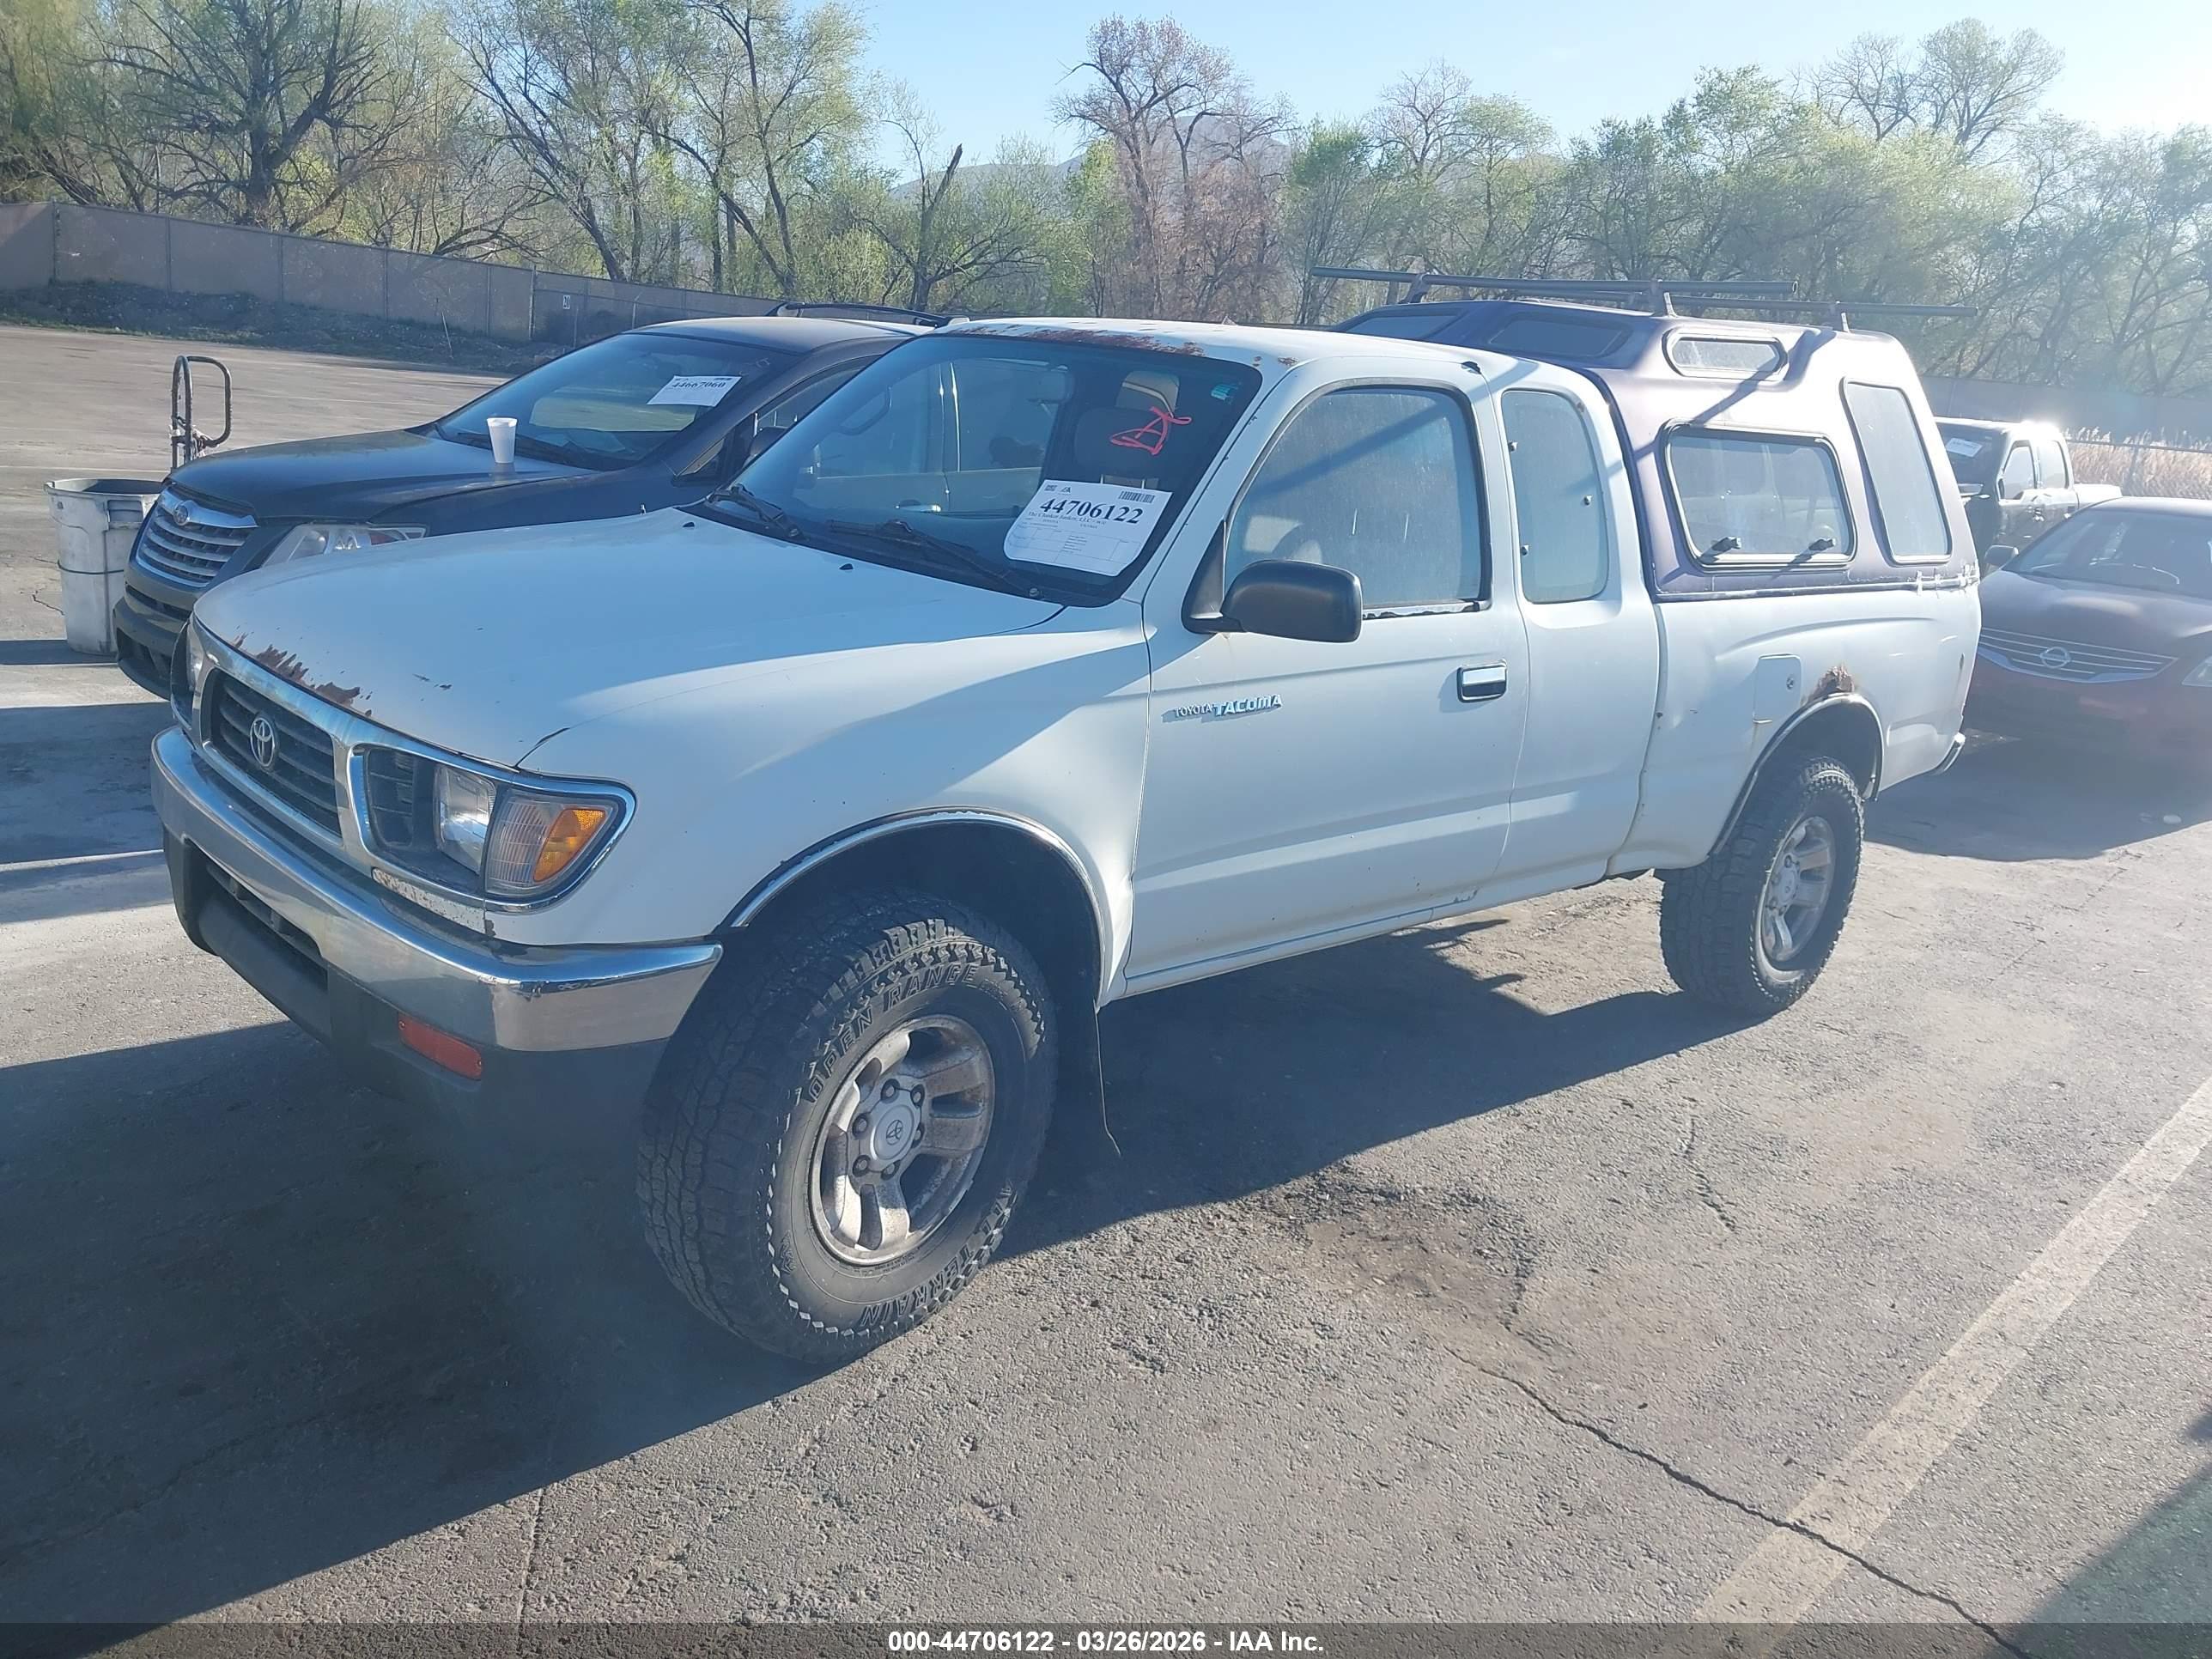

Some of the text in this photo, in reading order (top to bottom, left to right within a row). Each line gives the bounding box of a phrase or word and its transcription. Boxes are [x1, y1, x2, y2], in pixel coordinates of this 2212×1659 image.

[1040, 498, 1144, 525] 44706122
[1174, 694, 1283, 717] TOYOTA TACOMA
[805, 962, 979, 1103] OPEN RANGE
[860, 1244, 975, 1326] TERRAIN
